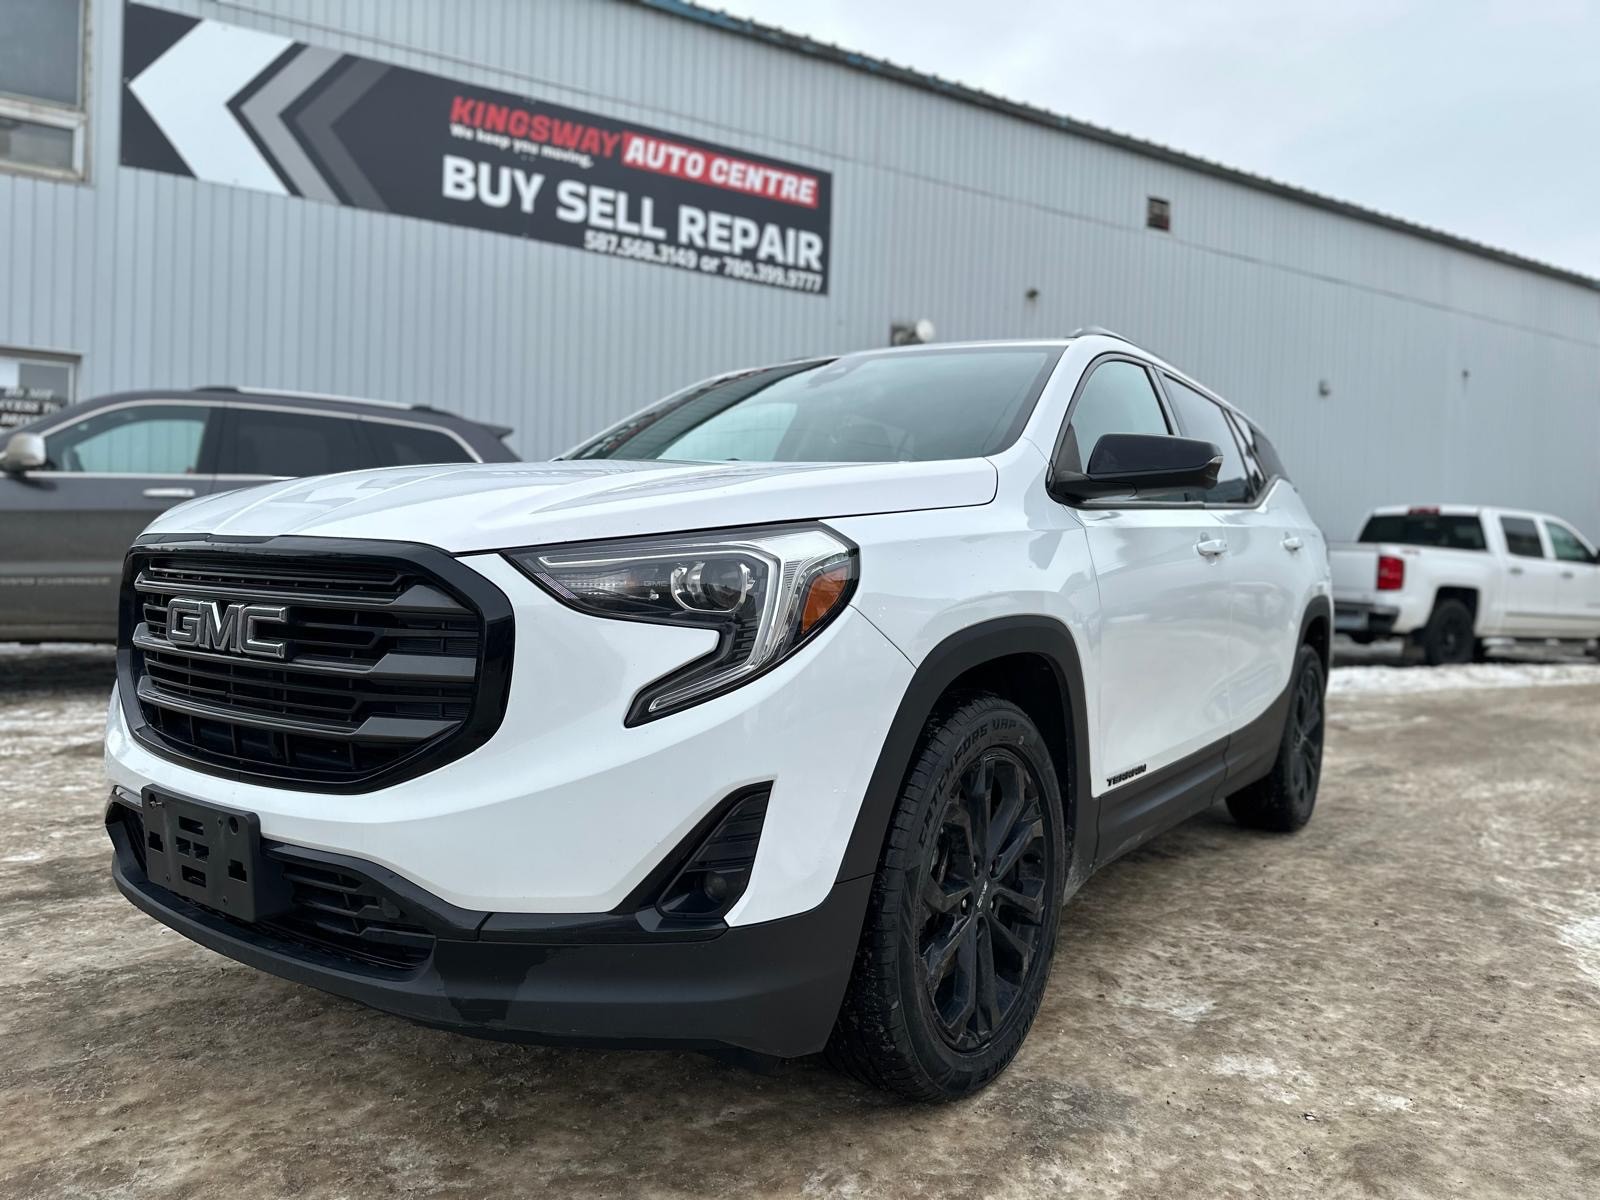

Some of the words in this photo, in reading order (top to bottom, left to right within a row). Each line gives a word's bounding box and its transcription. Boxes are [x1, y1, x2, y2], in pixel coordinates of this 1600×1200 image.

[450, 123, 474, 141] We
[475, 129, 511, 149] keep
[512, 138, 540, 154] you
[451, 95, 621, 158] KINGSWAY
[624, 136, 704, 179] AUTO
[709, 159, 818, 204] CENTRE
[442, 154, 545, 214] BUY
[556, 179, 667, 240] SELL
[678, 204, 823, 271] REPAIR
[700, 255, 722, 274] or
[166, 596, 290, 661] GMC
